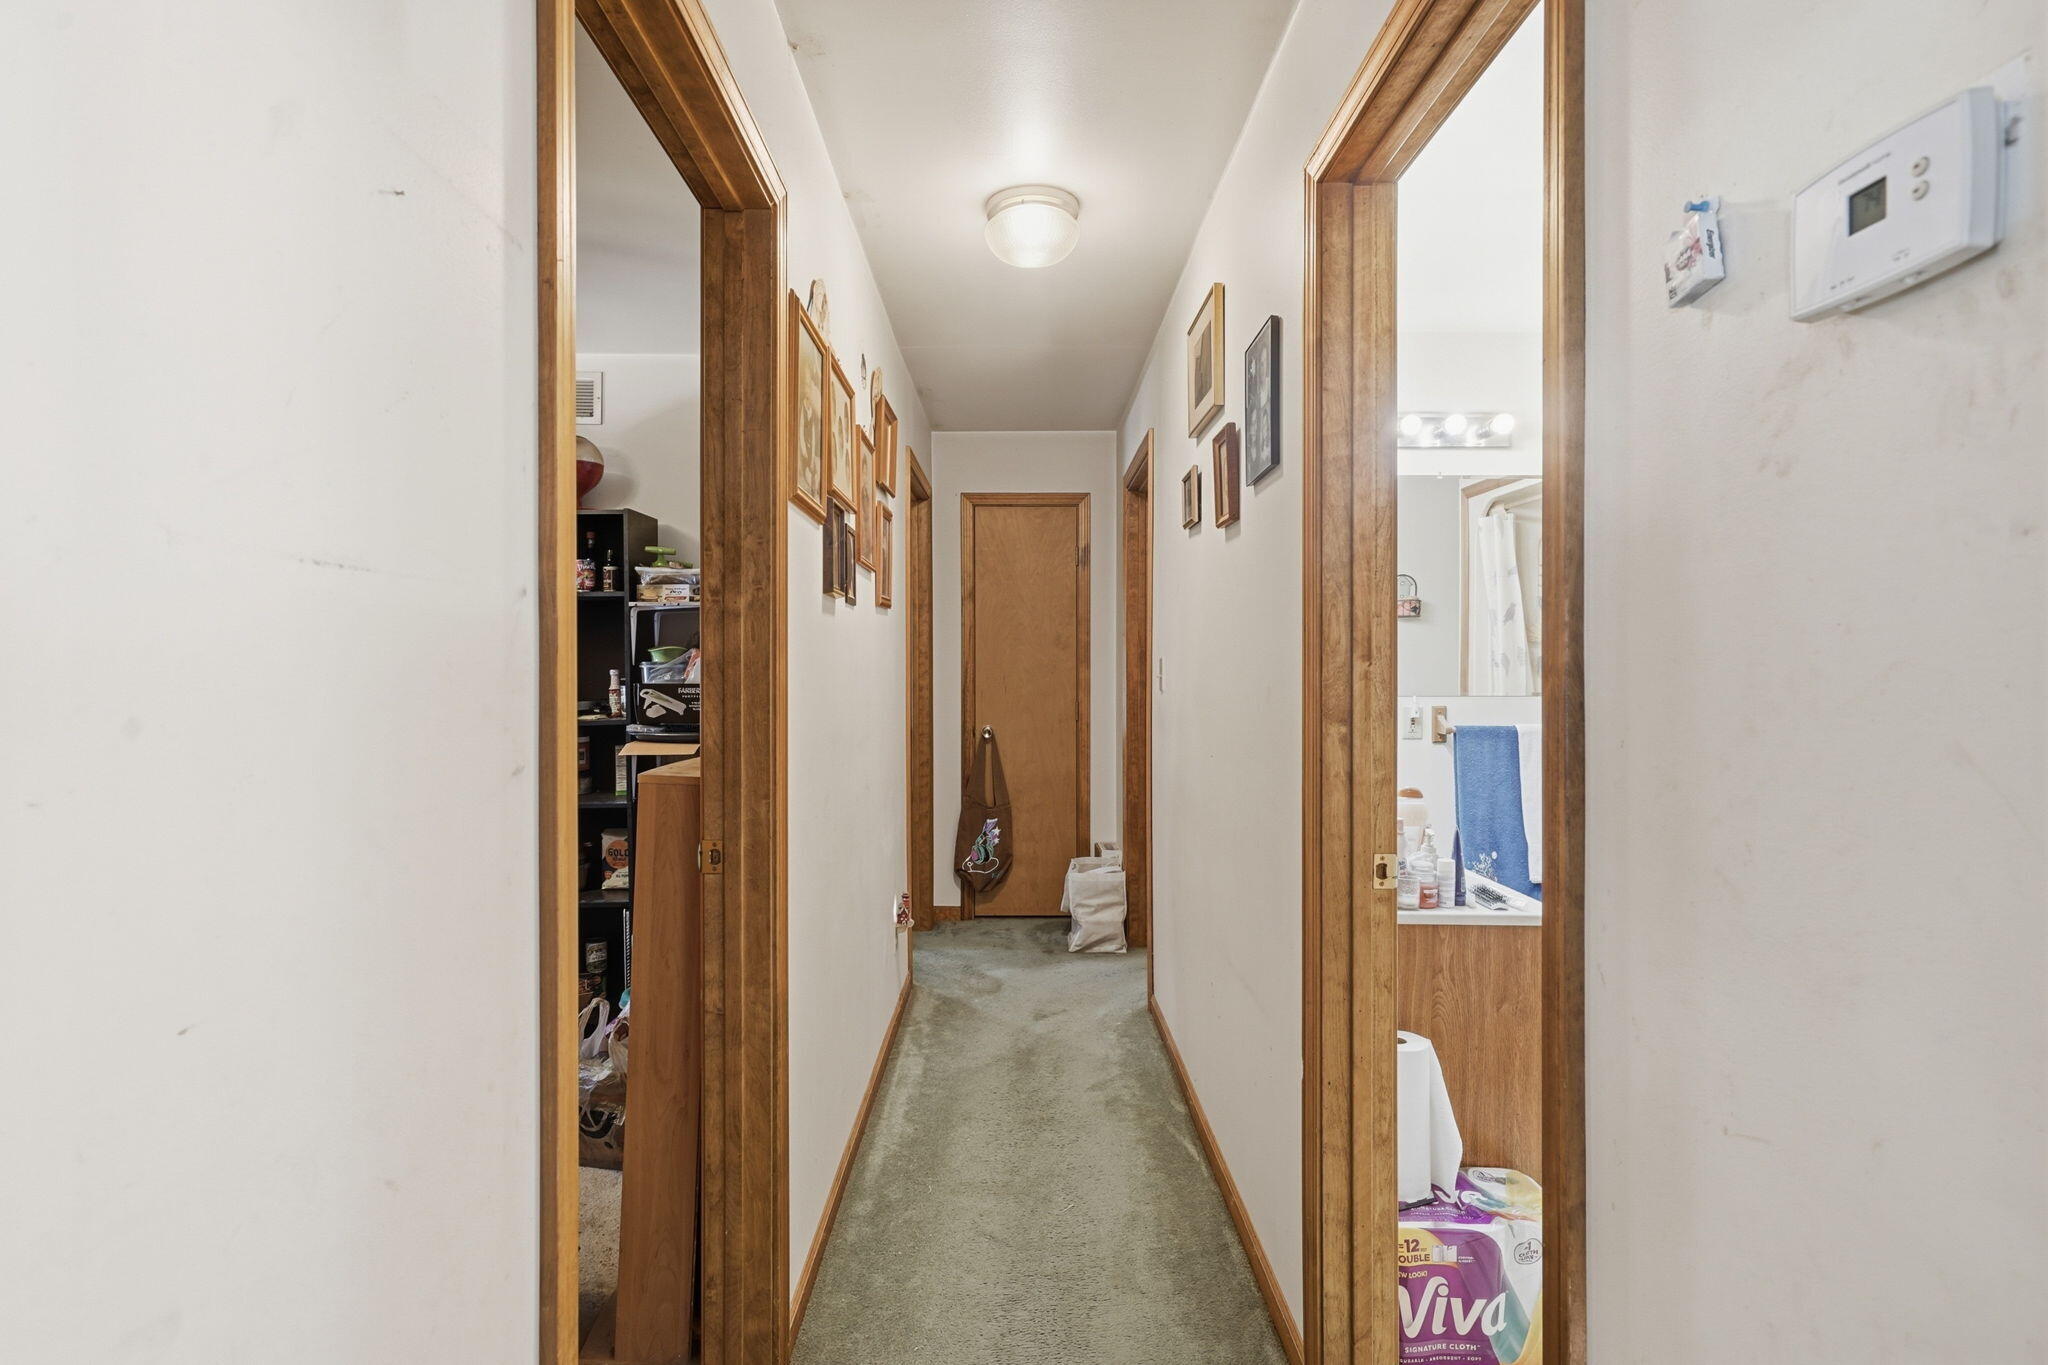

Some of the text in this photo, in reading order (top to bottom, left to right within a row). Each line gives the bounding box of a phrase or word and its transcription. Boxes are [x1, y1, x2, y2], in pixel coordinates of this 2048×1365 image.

[1706, 229, 1715, 259] Energizer
[1399, 1276, 1507, 1338] Viva
[1404, 1343, 1447, 1354] SIGNATURE
